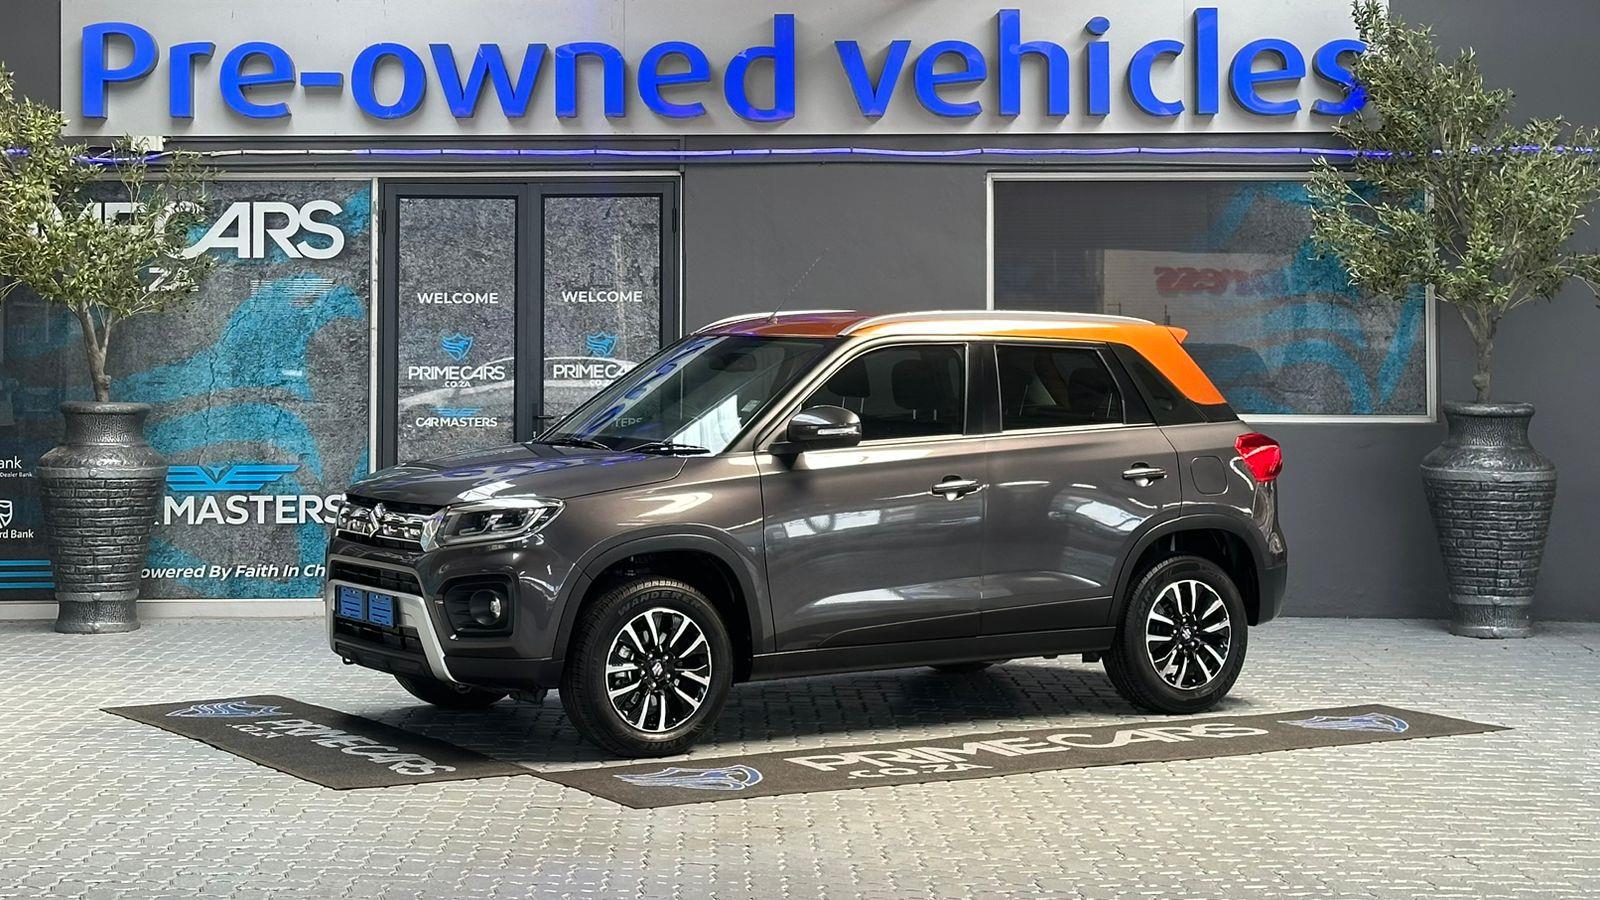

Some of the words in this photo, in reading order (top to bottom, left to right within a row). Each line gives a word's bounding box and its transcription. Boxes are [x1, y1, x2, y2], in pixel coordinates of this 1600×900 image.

[82, 13, 795, 122] Pre-owned
[834, 7, 1369, 118] vehicles
[417, 292, 499, 304] WELCOME
[561, 290, 643, 303] WELCOME
[408, 366, 506, 380] PRIMECARS
[415, 417, 498, 427] CARMASTERS
[153, 494, 340, 526] MASTERS
[11, 529, 34, 539] Bank
[209, 565, 232, 581] By
[235, 564, 278, 578] Faith
[283, 565, 299, 577] In
[254, 718, 457, 776] PRIMECARS
[783, 722, 1269, 772] PRIMECARS
